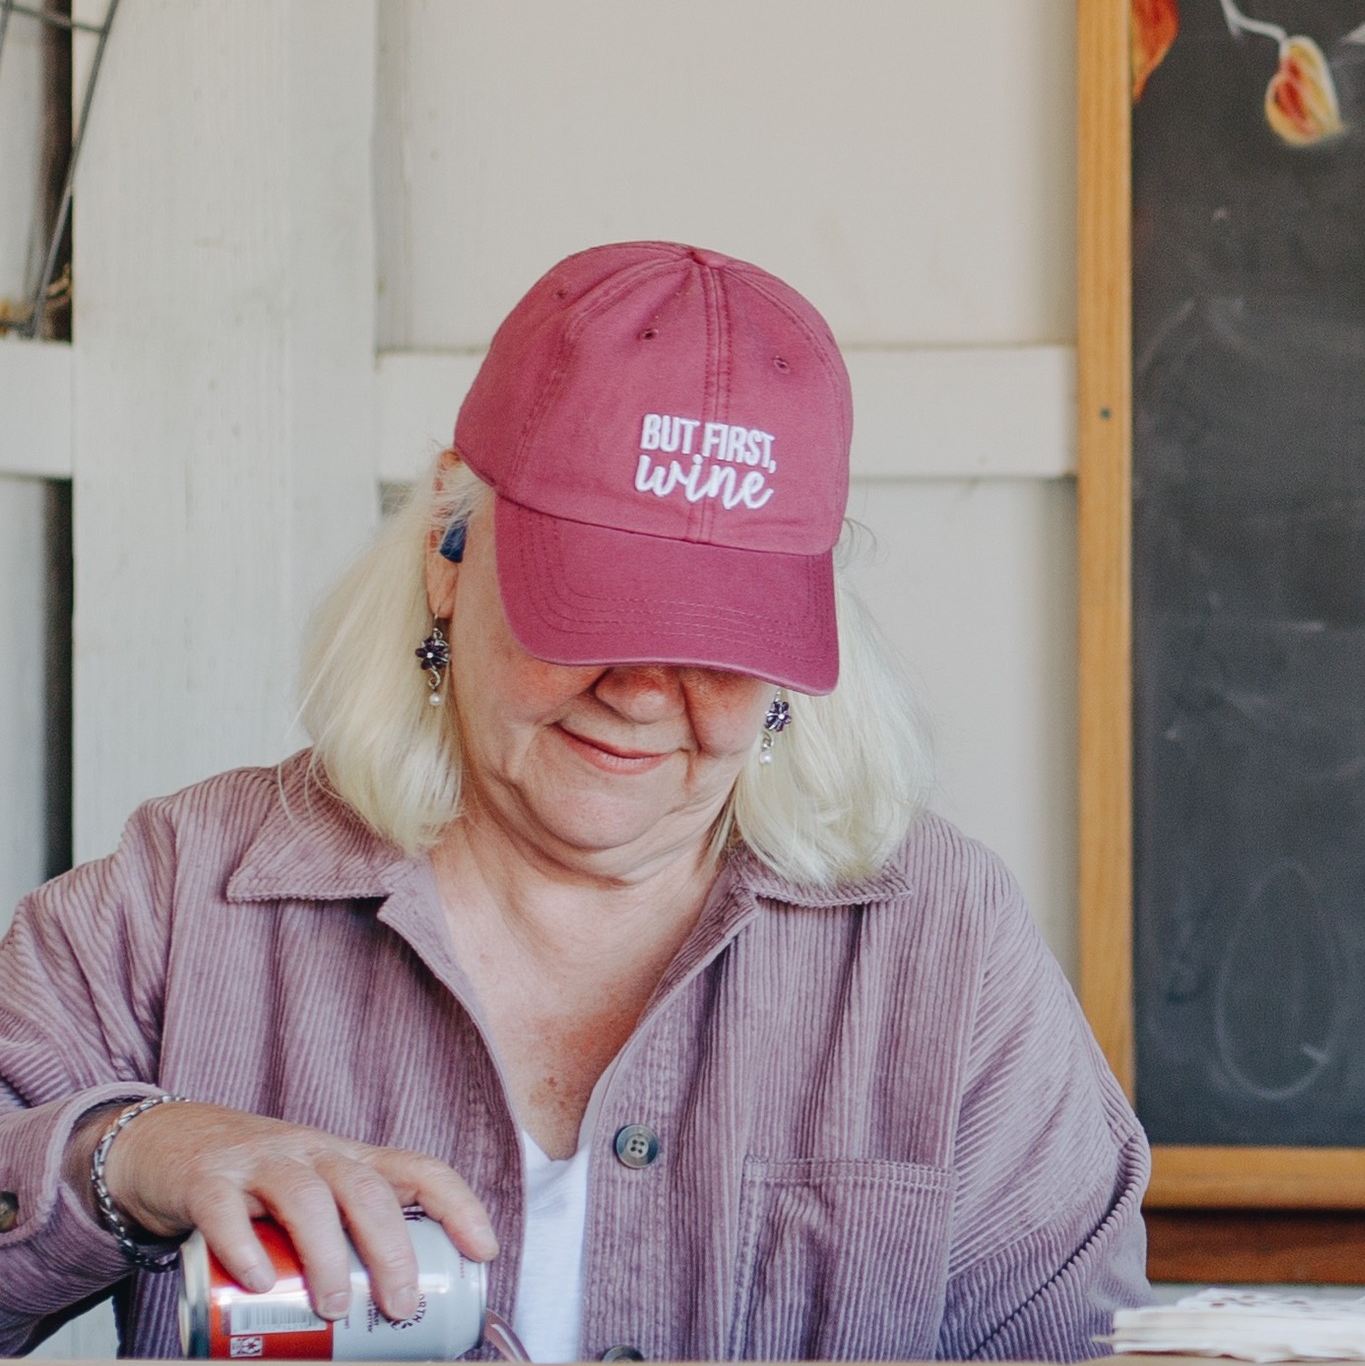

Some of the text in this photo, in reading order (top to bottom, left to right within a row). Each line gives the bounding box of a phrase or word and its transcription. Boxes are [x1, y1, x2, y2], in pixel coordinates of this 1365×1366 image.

[639, 413, 778, 474] BUT FIRST,
[634, 453, 775, 510] wine
